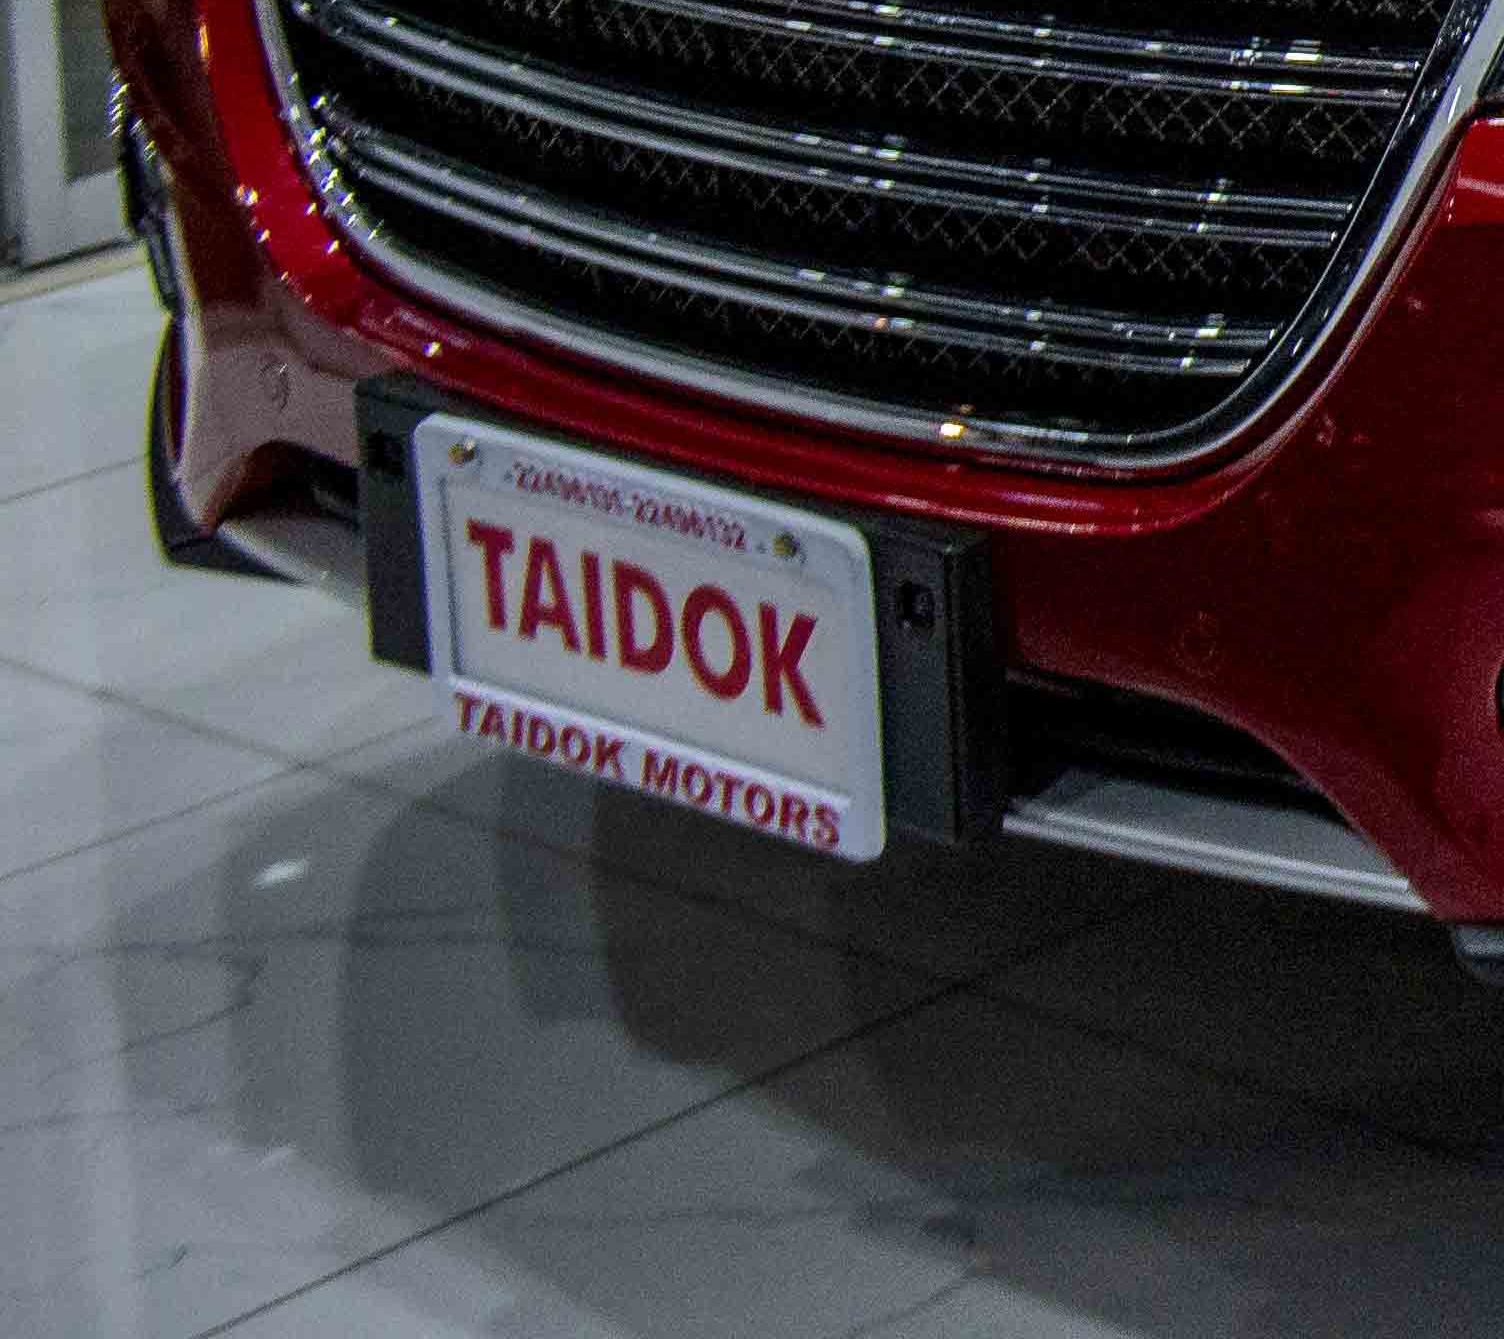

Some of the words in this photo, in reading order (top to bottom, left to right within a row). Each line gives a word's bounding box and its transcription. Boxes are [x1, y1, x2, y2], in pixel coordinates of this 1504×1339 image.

[466, 517, 826, 731] TAIDOK
[453, 689, 627, 781] TAIDOK
[641, 745, 841, 851] MOTORS
